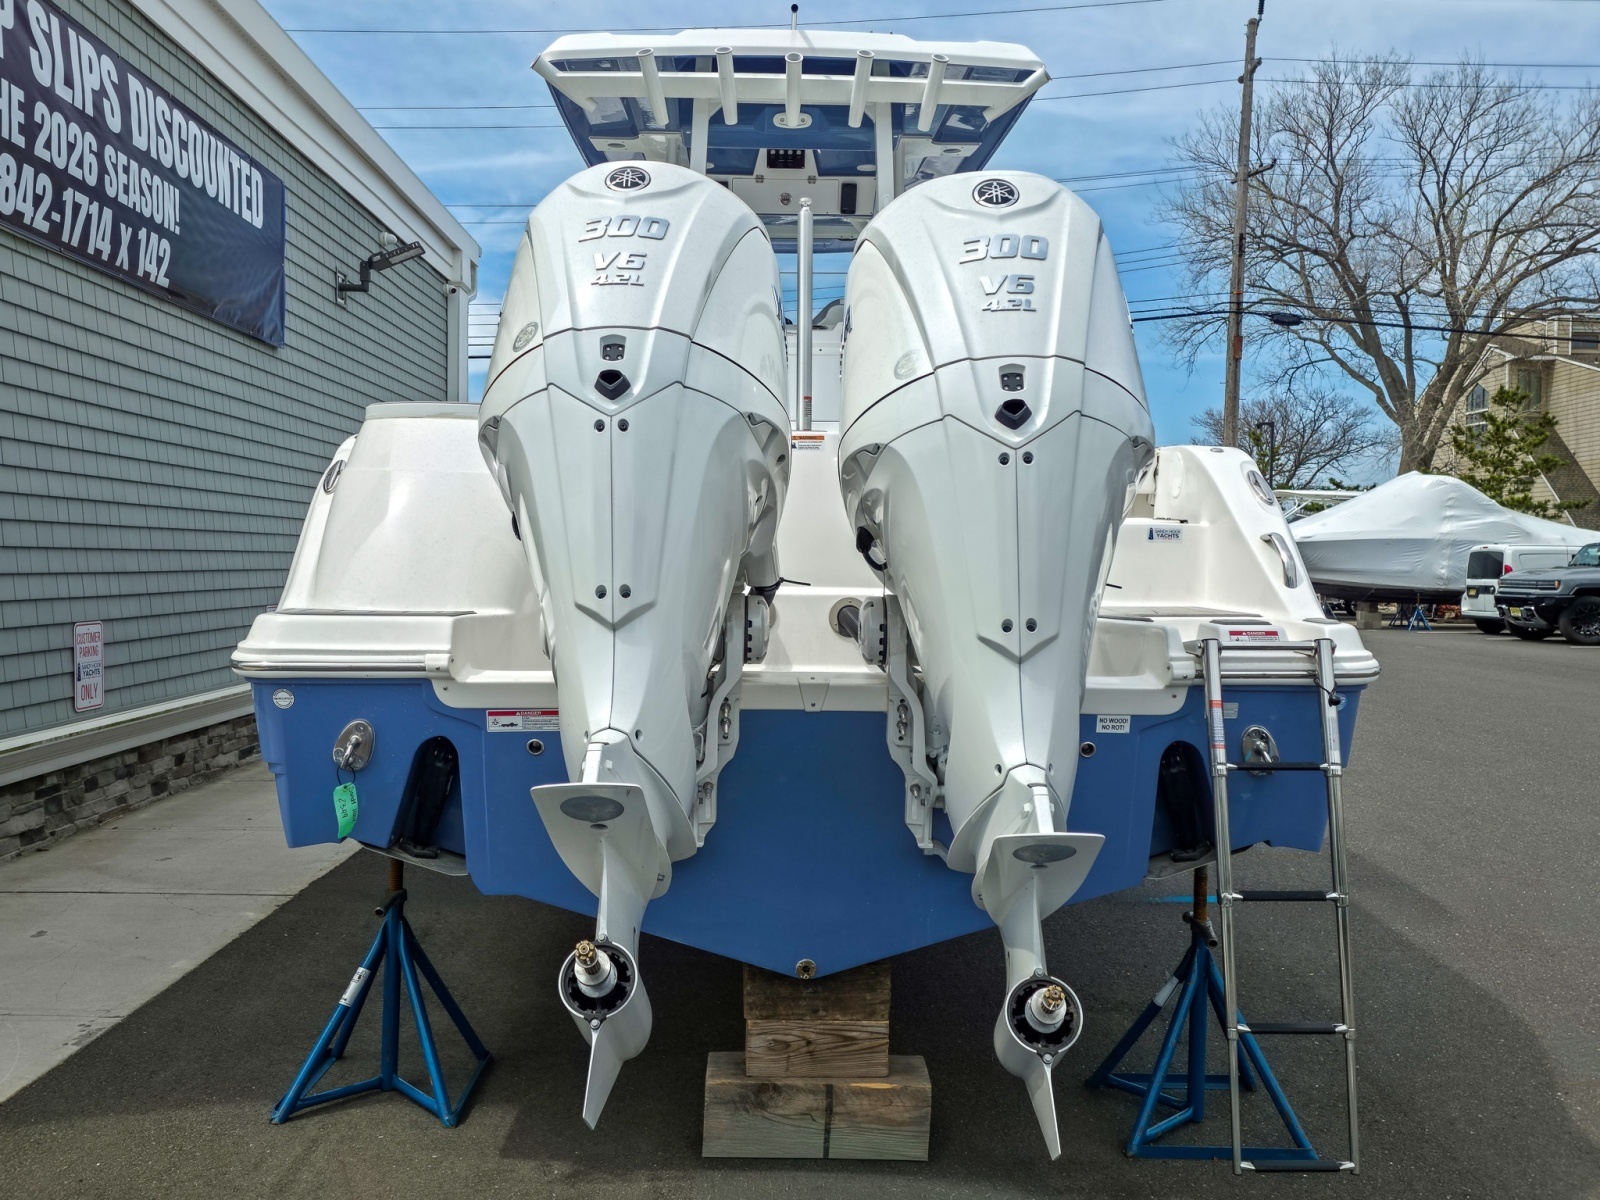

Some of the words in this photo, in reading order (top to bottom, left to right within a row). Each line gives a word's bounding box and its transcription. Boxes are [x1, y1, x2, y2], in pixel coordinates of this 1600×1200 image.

[27, 0, 121, 133] SLIPS
[127, 73, 263, 229] DISCOUNTED
[34, 102, 98, 187] 2026
[104, 144, 180, 235] SEASON!
[579, 215, 670, 242] 300
[137, 227, 171, 288] 142
[959, 234, 1049, 264] 300
[593, 251, 647, 270] V6
[591, 273, 645, 286] 4.2L
[979, 274, 1035, 295] V6
[982, 298, 1037, 312] 4.2L
[77, 632, 100, 645] CUSTOMER
[80, 645, 98, 657] PARKING
[82, 668, 101, 677] YACHTS
[81, 683, 98, 701] ONLY
